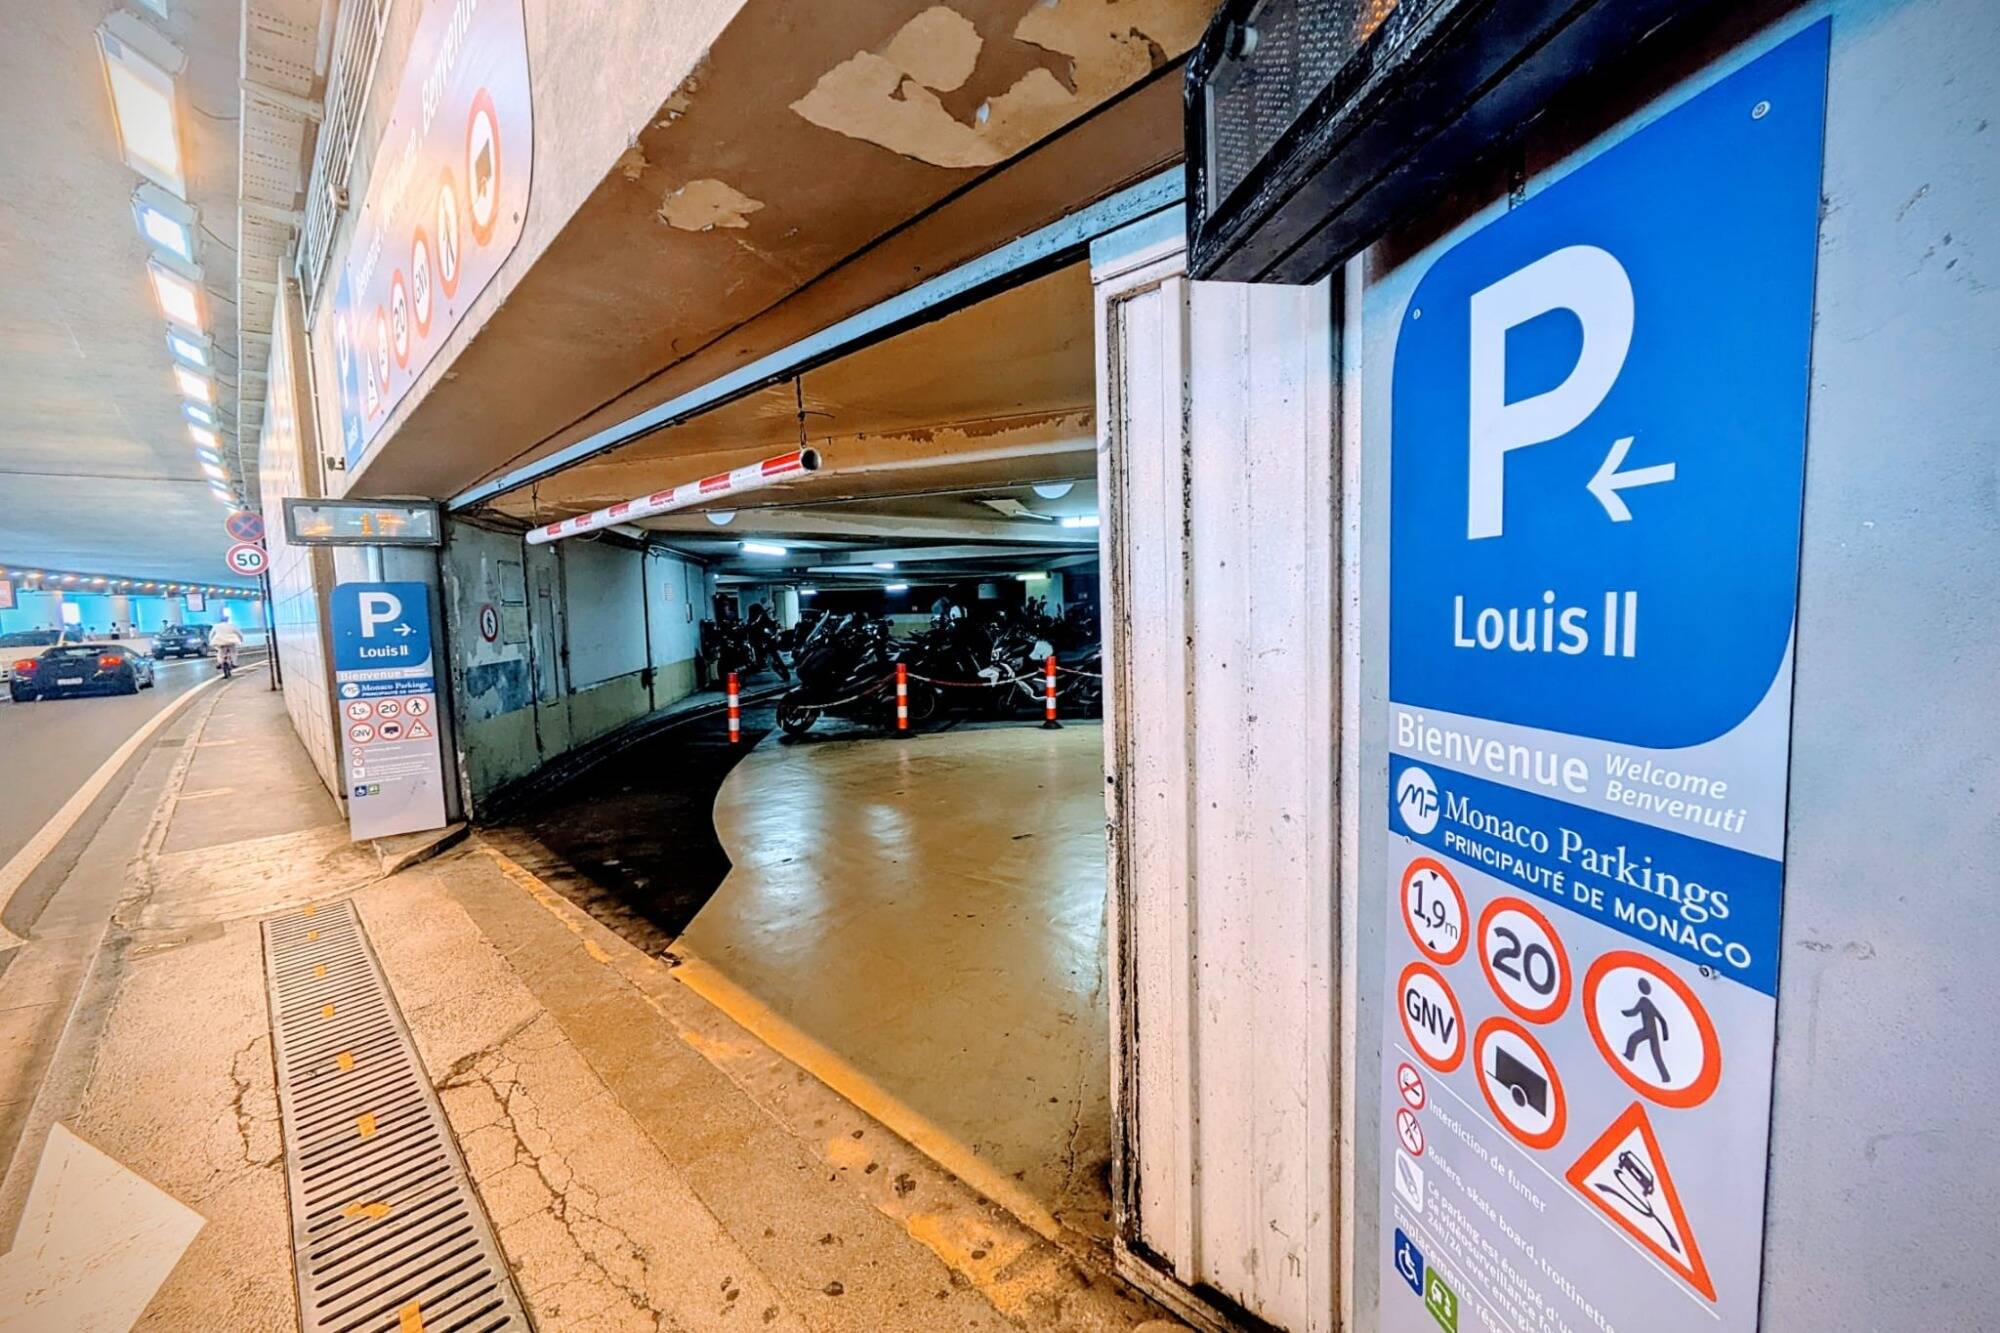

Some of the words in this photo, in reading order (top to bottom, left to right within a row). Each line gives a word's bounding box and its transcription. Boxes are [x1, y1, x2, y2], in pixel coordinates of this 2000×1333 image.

[1466, 244, 1636, 541] P
[236, 553, 261, 567] 50
[358, 592, 402, 638] P
[1453, 588, 1589, 655] Louis
[1603, 590, 1638, 658] II
[359, 645, 398, 658] Louis
[399, 644, 409, 656] II
[381, 704, 399, 714] 20
[1398, 711, 1589, 794] Bienvenue
[1605, 753, 1728, 800] Welcome
[1605, 780, 1747, 834] Benvenuti
[1444, 790, 1550, 854] Monaco
[1558, 826, 1730, 924] Parkings
[1444, 831, 1565, 895] PRINCIPAUTÉ
[1573, 881, 1604, 911] DE
[1614, 897, 1752, 969] MONACO
[1491, 926, 1556, 996] 20
[1405, 988, 1455, 1045] GNV
[1430, 1099, 1488, 1161] Interdiction
[1490, 1156, 1505, 1177] de
[1507, 1170, 1547, 1214] fumer
[1393, 1204, 1473, 1307] Emplacements
[1441, 1196, 1480, 1245] parking
[1481, 1239, 1499, 1264] est
[1501, 1257, 1544, 1310] équipé
[1466, 1186, 1497, 1222] skate
[1499, 1215, 1539, 1265] board,
[1465, 1256, 1491, 1289] avec
